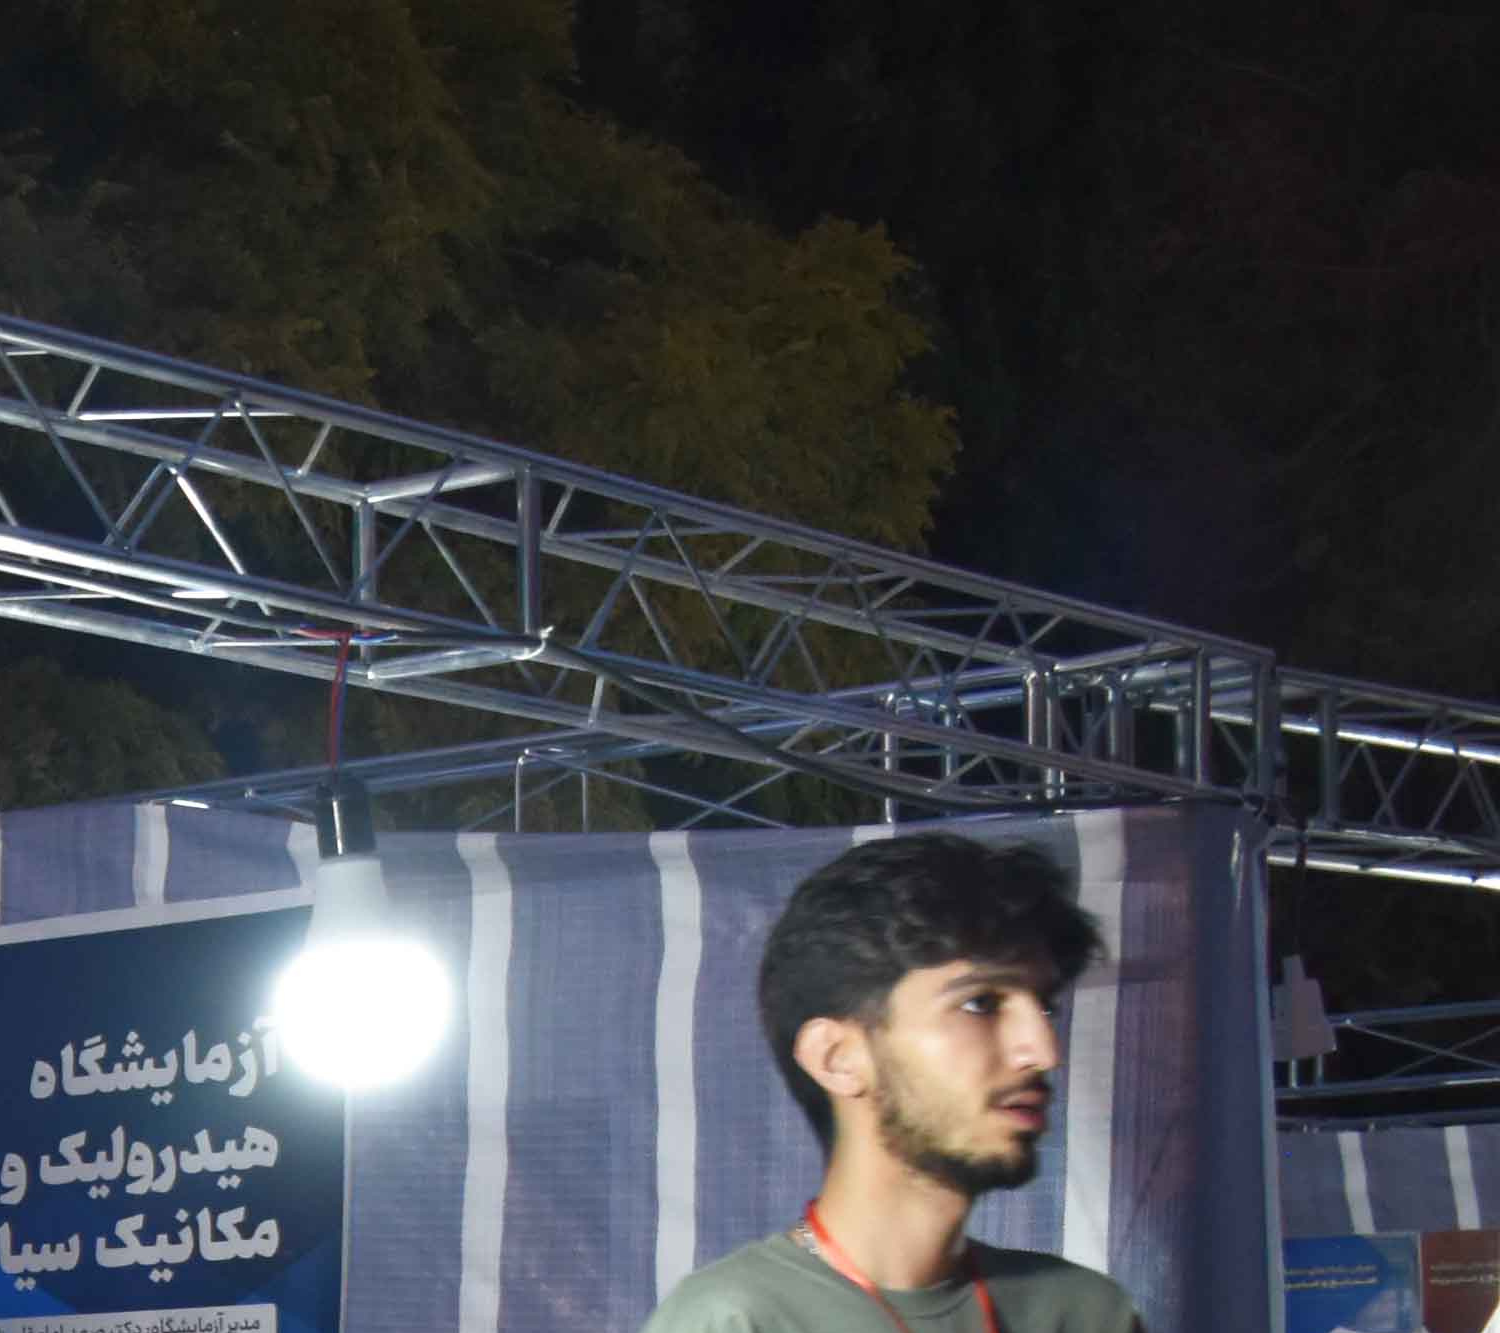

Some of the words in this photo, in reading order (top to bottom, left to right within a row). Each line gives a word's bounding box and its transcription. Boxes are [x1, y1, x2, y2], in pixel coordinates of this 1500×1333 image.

[29, 1016, 282, 1106] آزمایشگاه
[38, 1125, 279, 1199] هیدرولیک
[95, 1205, 280, 1283] مکانیک
